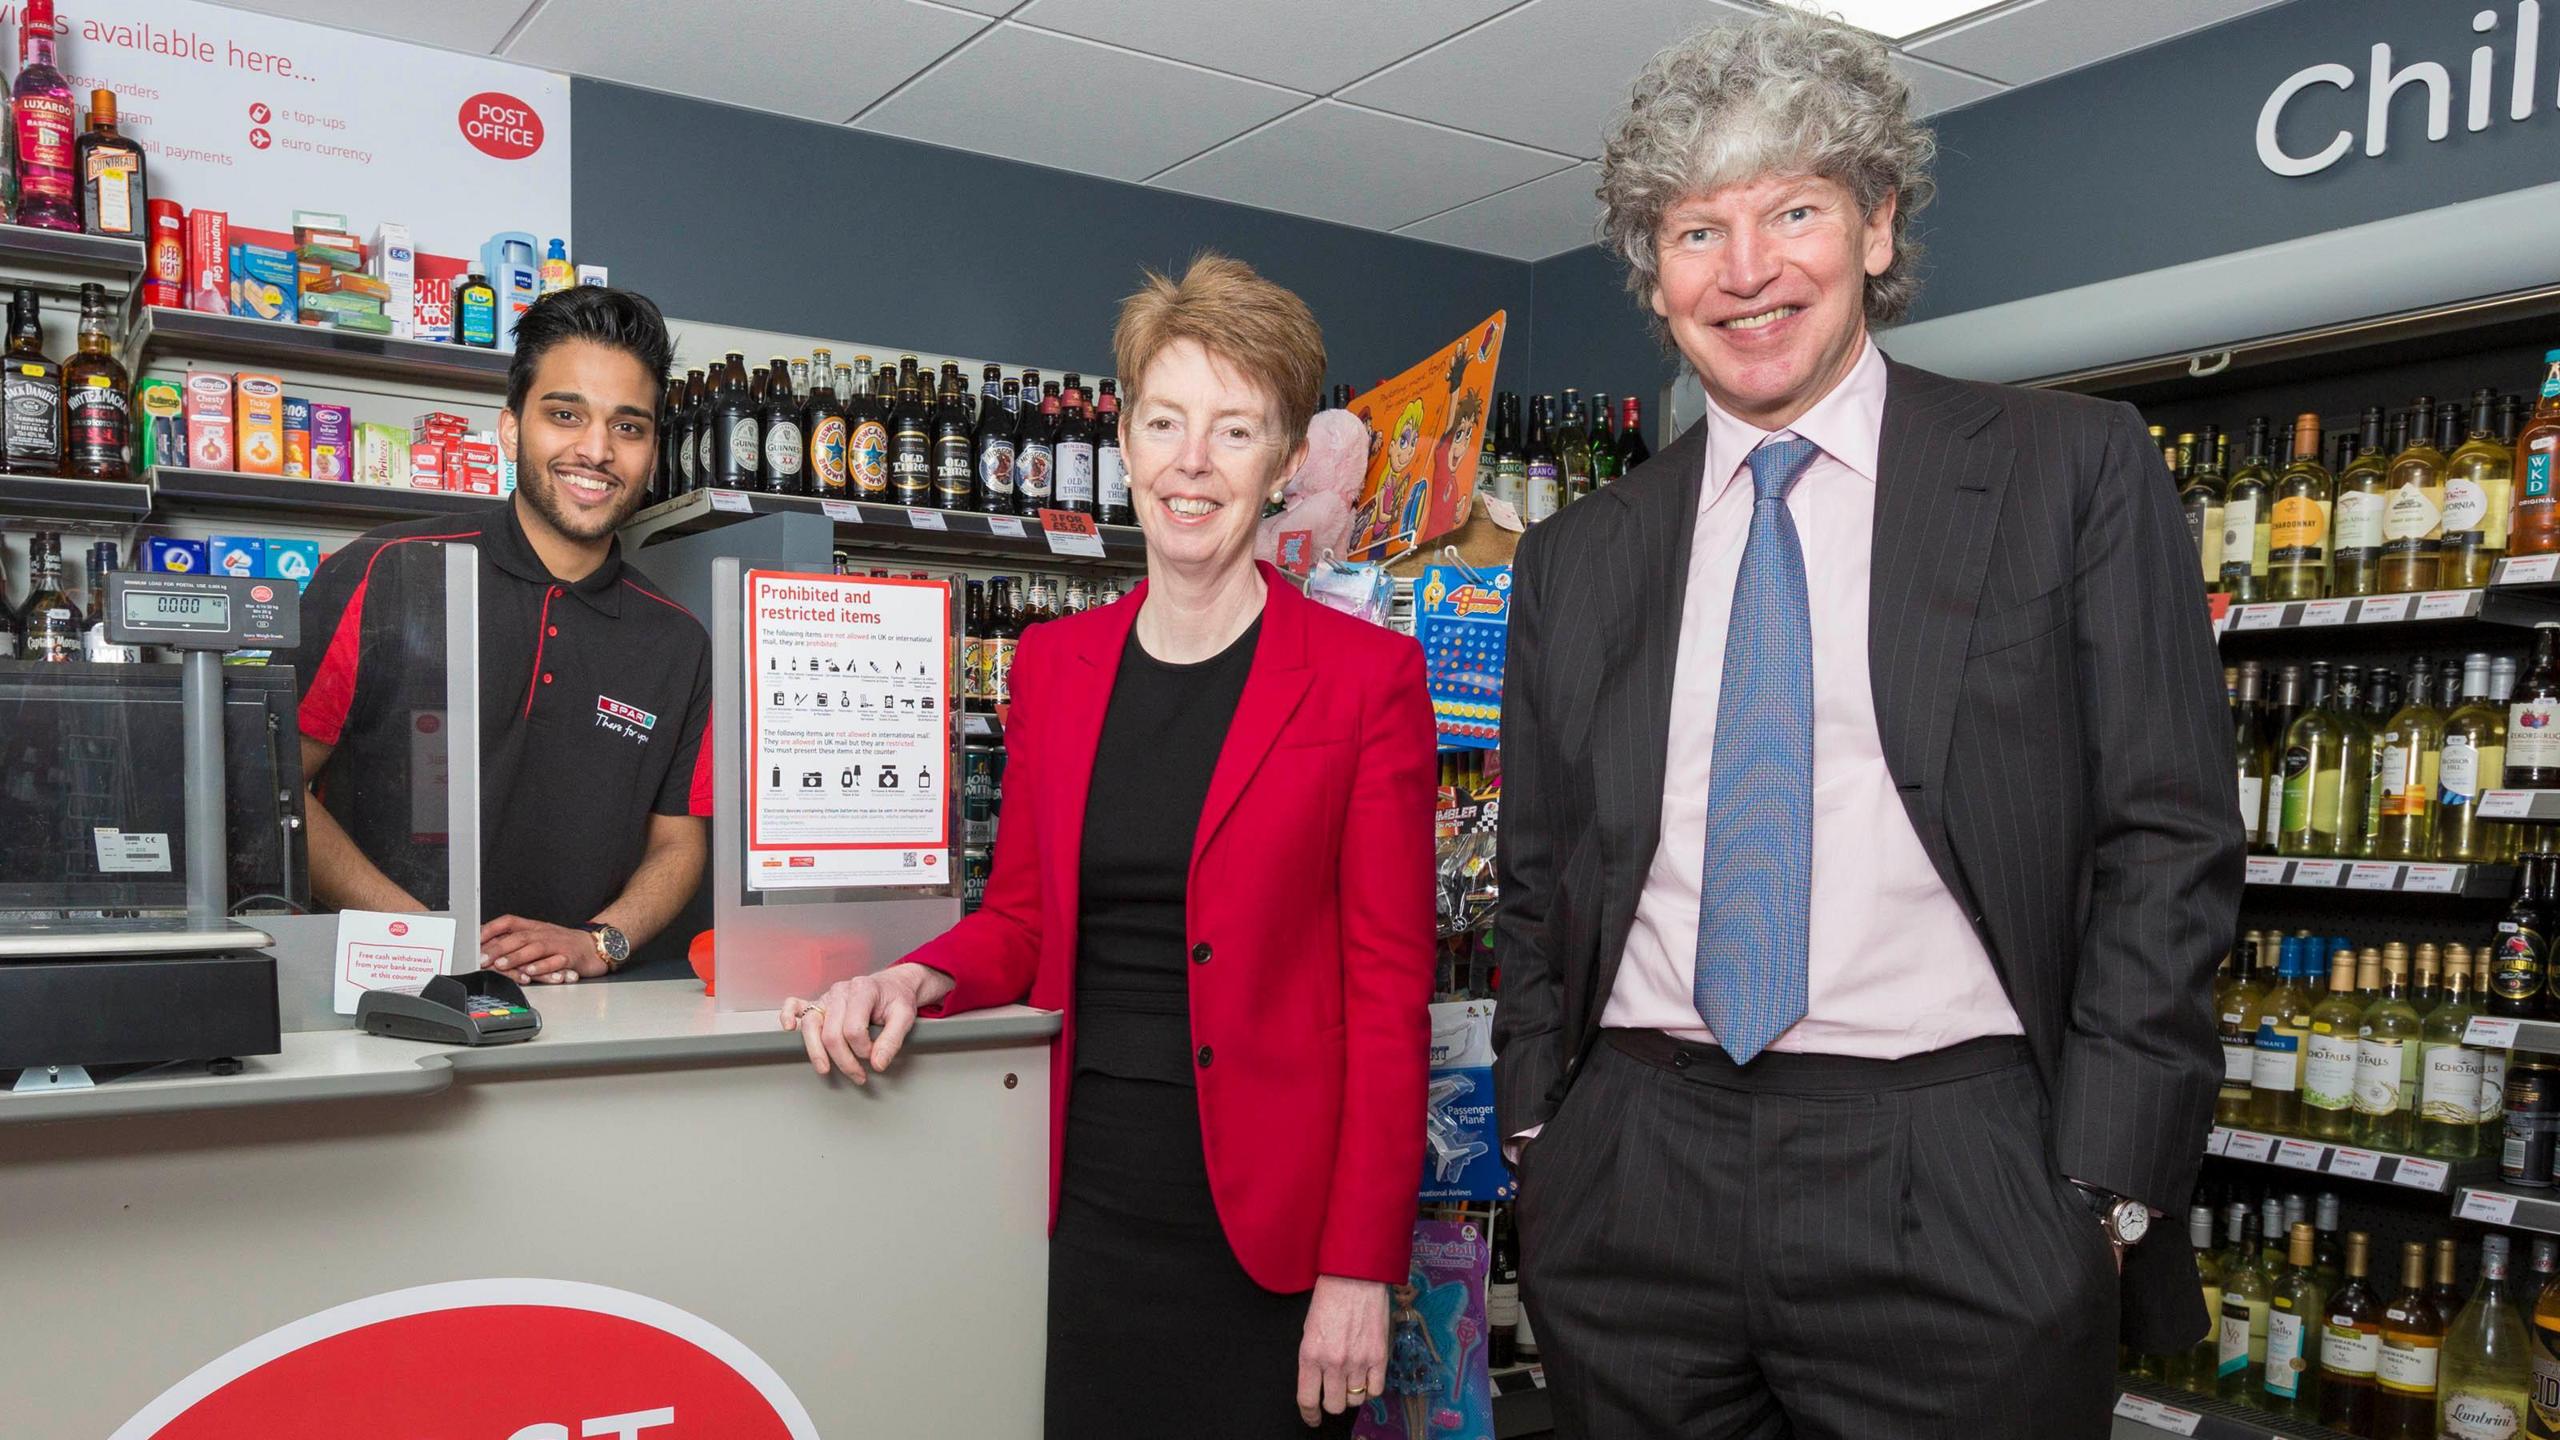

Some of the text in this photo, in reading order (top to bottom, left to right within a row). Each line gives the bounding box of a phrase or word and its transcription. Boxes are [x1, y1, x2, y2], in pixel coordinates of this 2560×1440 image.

[83, 21, 317, 83] available here...
[66, 74, 160, 101] postal orders
[2255, 0, 2560, 177] Chil
[23, 99, 71, 116] LUXARDO
[281, 110, 347, 131] e top-ups
[479, 103, 528, 128] POST
[466, 121, 535, 148] OFFICE
[140, 140, 233, 167] bill payments
[281, 136, 373, 165] euro currency
[90, 155, 136, 175] COINTREAU
[212, 215, 224, 283] Ibuprofen Gel
[390, 249, 410, 260] E45
[159, 260, 180, 278] HEAT
[387, 271, 409, 279] cream
[515, 275, 532, 283] NIVEA
[414, 278, 451, 306] PRO
[4, 385, 26, 400] JACK
[196, 394, 226, 406] Chesty
[899, 452, 924, 464] OLD
[1496, 462, 1514, 473] GRAN
[1528, 465, 1548, 477] GRAN
[1066, 478, 1083, 486] OLD
[1059, 513, 1082, 523] FOR
[761, 584, 871, 605] Prohibited and
[158, 596, 201, 614] 0.000
[761, 606, 882, 625] restricted items
[763, 628, 774, 637] The
[775, 629, 804, 639] following
[804, 630, 822, 638] items
[846, 632, 870, 641] allowed
[877, 633, 887, 641] UK
[895, 634, 933, 643] international
[779, 639, 793, 648] they
[609, 703, 645, 723] SPAR
[595, 712, 649, 745] There for you
[764, 729, 776, 737] The
[777, 729, 805, 739] following
[847, 731, 870, 739] allowed
[878, 731, 915, 740] international
[764, 737, 779, 747] They
[791, 738, 816, 746] allowed
[824, 738, 834, 746] UK
[848, 739, 860, 747] but
[860, 739, 874, 748] they
[793, 747, 818, 756] present
[818, 747, 836, 755] these
[836, 747, 851, 755] items
[358, 951, 432, 965] Free cash withdrawals
[355, 960, 434, 974] from your bank account
[378, 971, 390, 980] this
[391, 973, 418, 981] counter
[2325, 1052, 2351, 1062] FALLS
[2363, 1054, 2390, 1067] FALLS
[2434, 1062, 2463, 1073] ECHO
[1447, 1105, 1495, 1116] Passenger
[1459, 1115, 1486, 1125] Plane
[1448, 1188, 1472, 1198] Airlines
[2450, 1403, 2512, 1428] Lambrini
